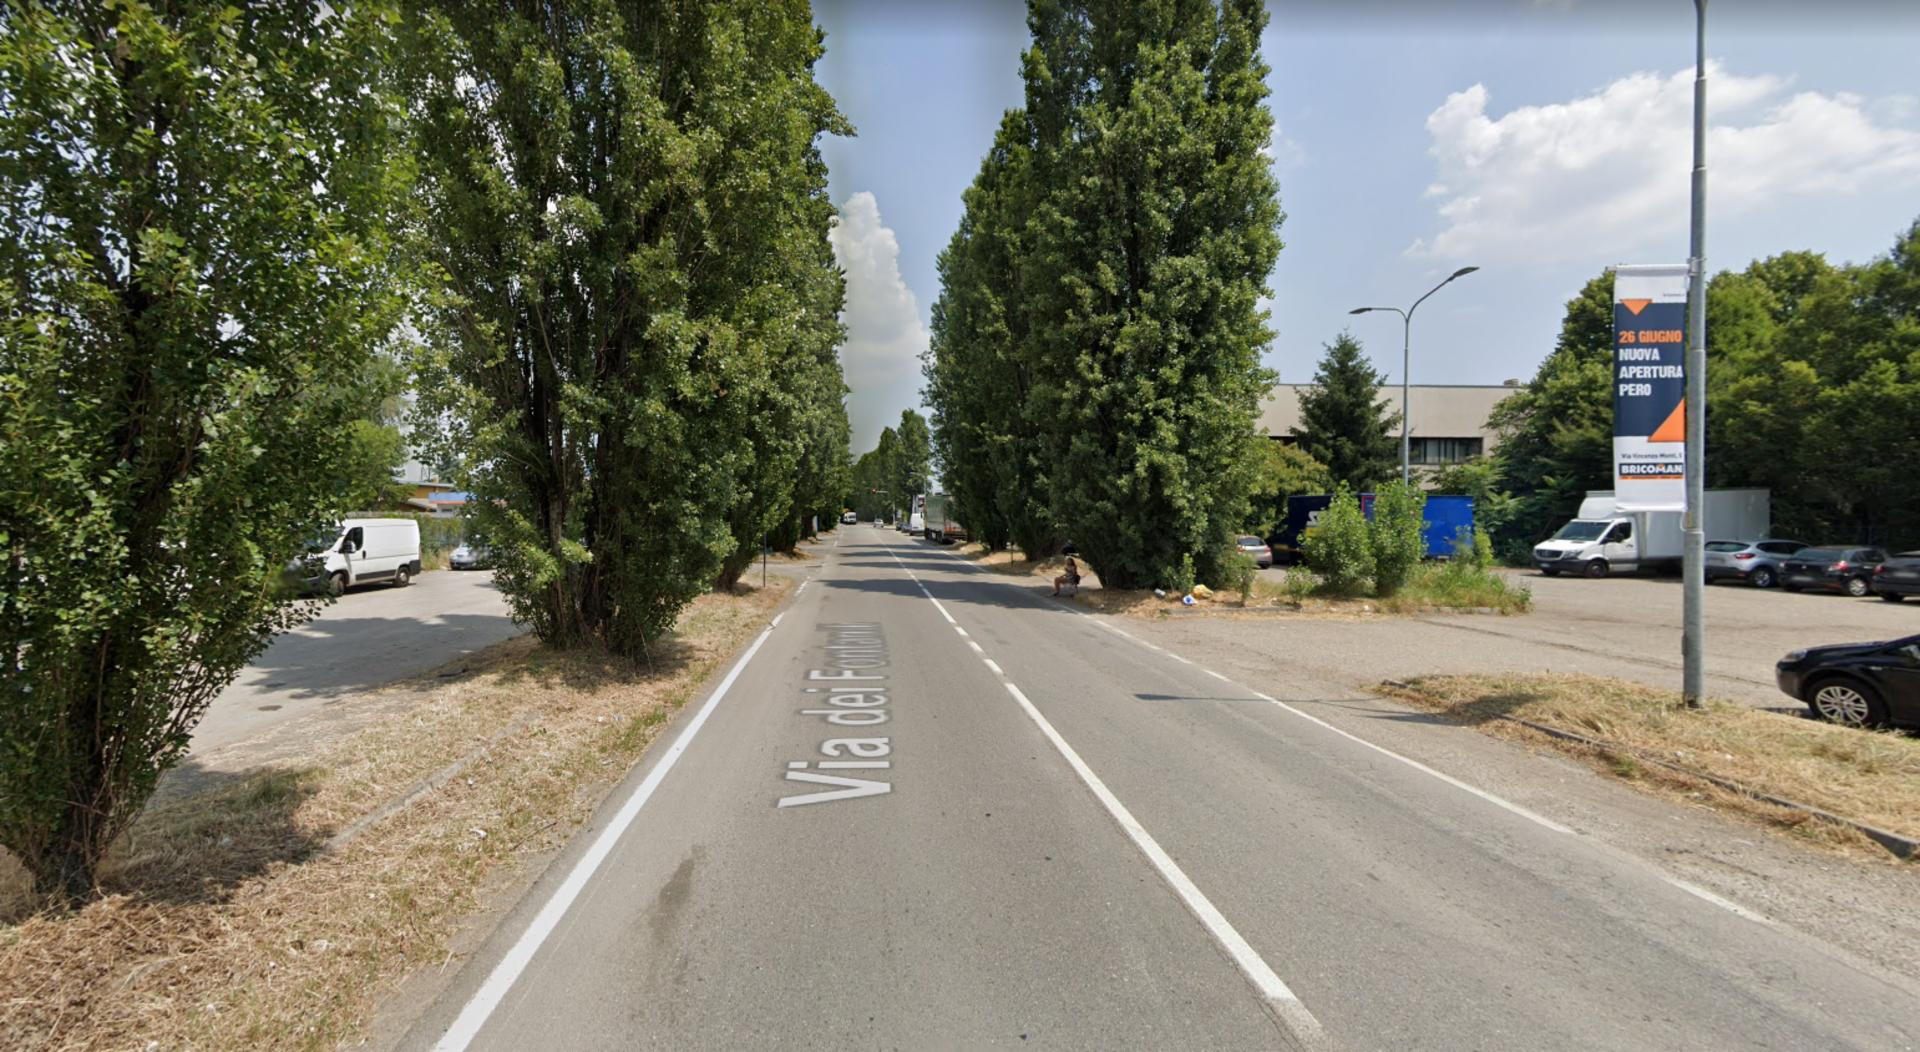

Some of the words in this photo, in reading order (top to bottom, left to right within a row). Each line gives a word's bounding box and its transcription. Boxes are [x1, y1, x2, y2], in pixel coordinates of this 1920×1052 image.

[1619, 331, 1636, 343] 26
[1639, 330, 1683, 343] GIUGNO
[1619, 348, 1660, 361] NUOVA
[1619, 366, 1684, 379] APERTURA
[1619, 384, 1652, 396] PERO
[1621, 464, 1683, 474] BRICOMAN
